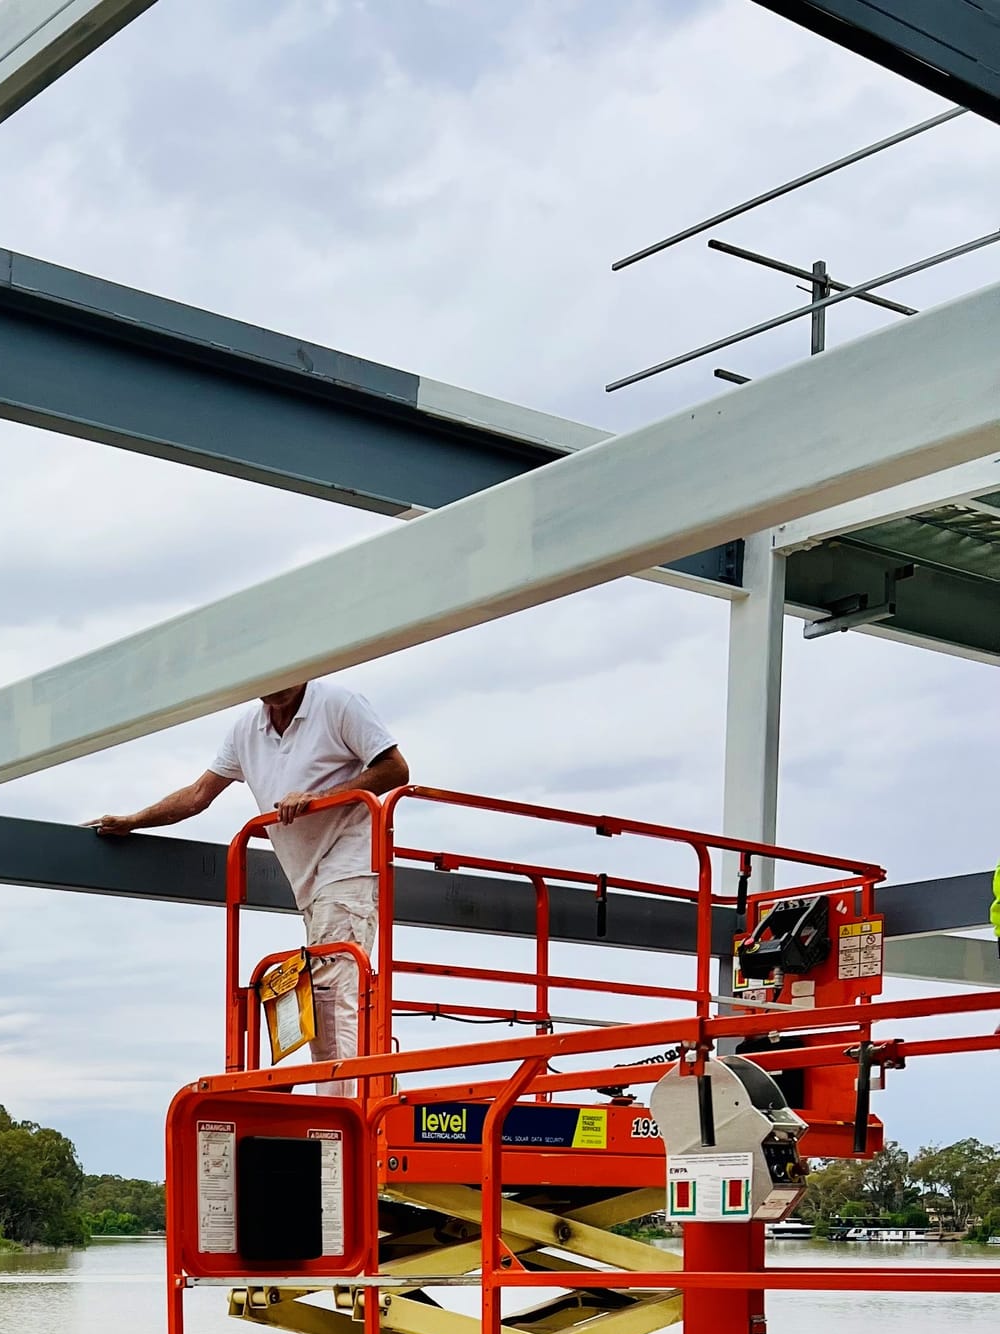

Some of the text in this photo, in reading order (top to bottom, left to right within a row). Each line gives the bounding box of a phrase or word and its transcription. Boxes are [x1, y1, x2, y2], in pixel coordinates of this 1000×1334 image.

[422, 1106, 467, 1133] level
[206, 1124, 232, 1132] DANGER
[632, 1118, 663, 1137] 193
[314, 1132, 340, 1140] DANGER
